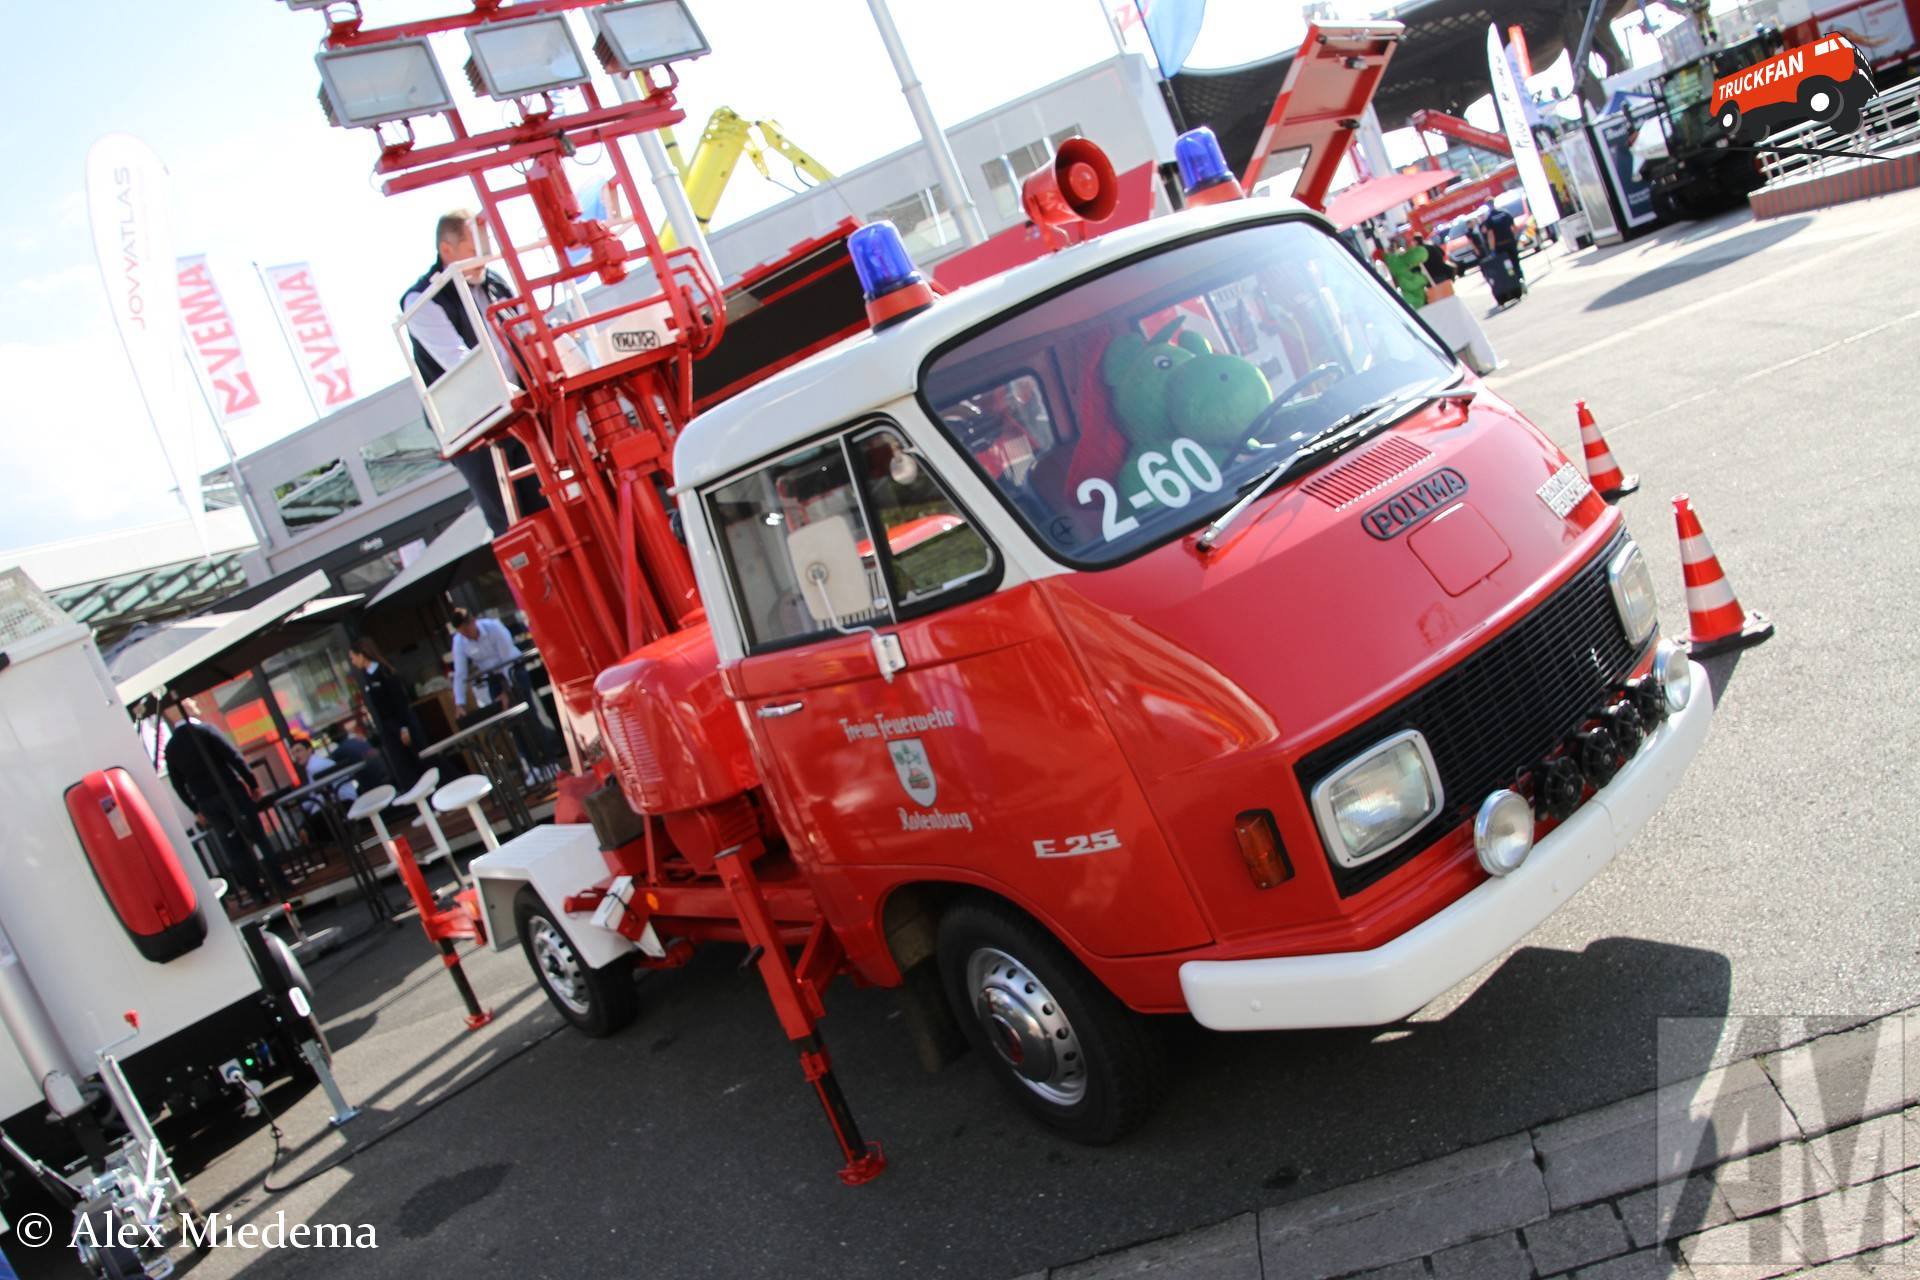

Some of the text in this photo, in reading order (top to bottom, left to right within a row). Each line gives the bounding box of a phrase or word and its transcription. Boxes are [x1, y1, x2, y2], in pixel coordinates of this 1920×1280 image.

[177, 263, 241, 376] VEMA
[278, 270, 341, 371] VEMA
[1077, 437, 1223, 542] 2-60
[1368, 472, 1465, 537] POLYMA
[874, 706, 956, 740] Feuerwehr
[898, 807, 973, 832] Rotenburg
